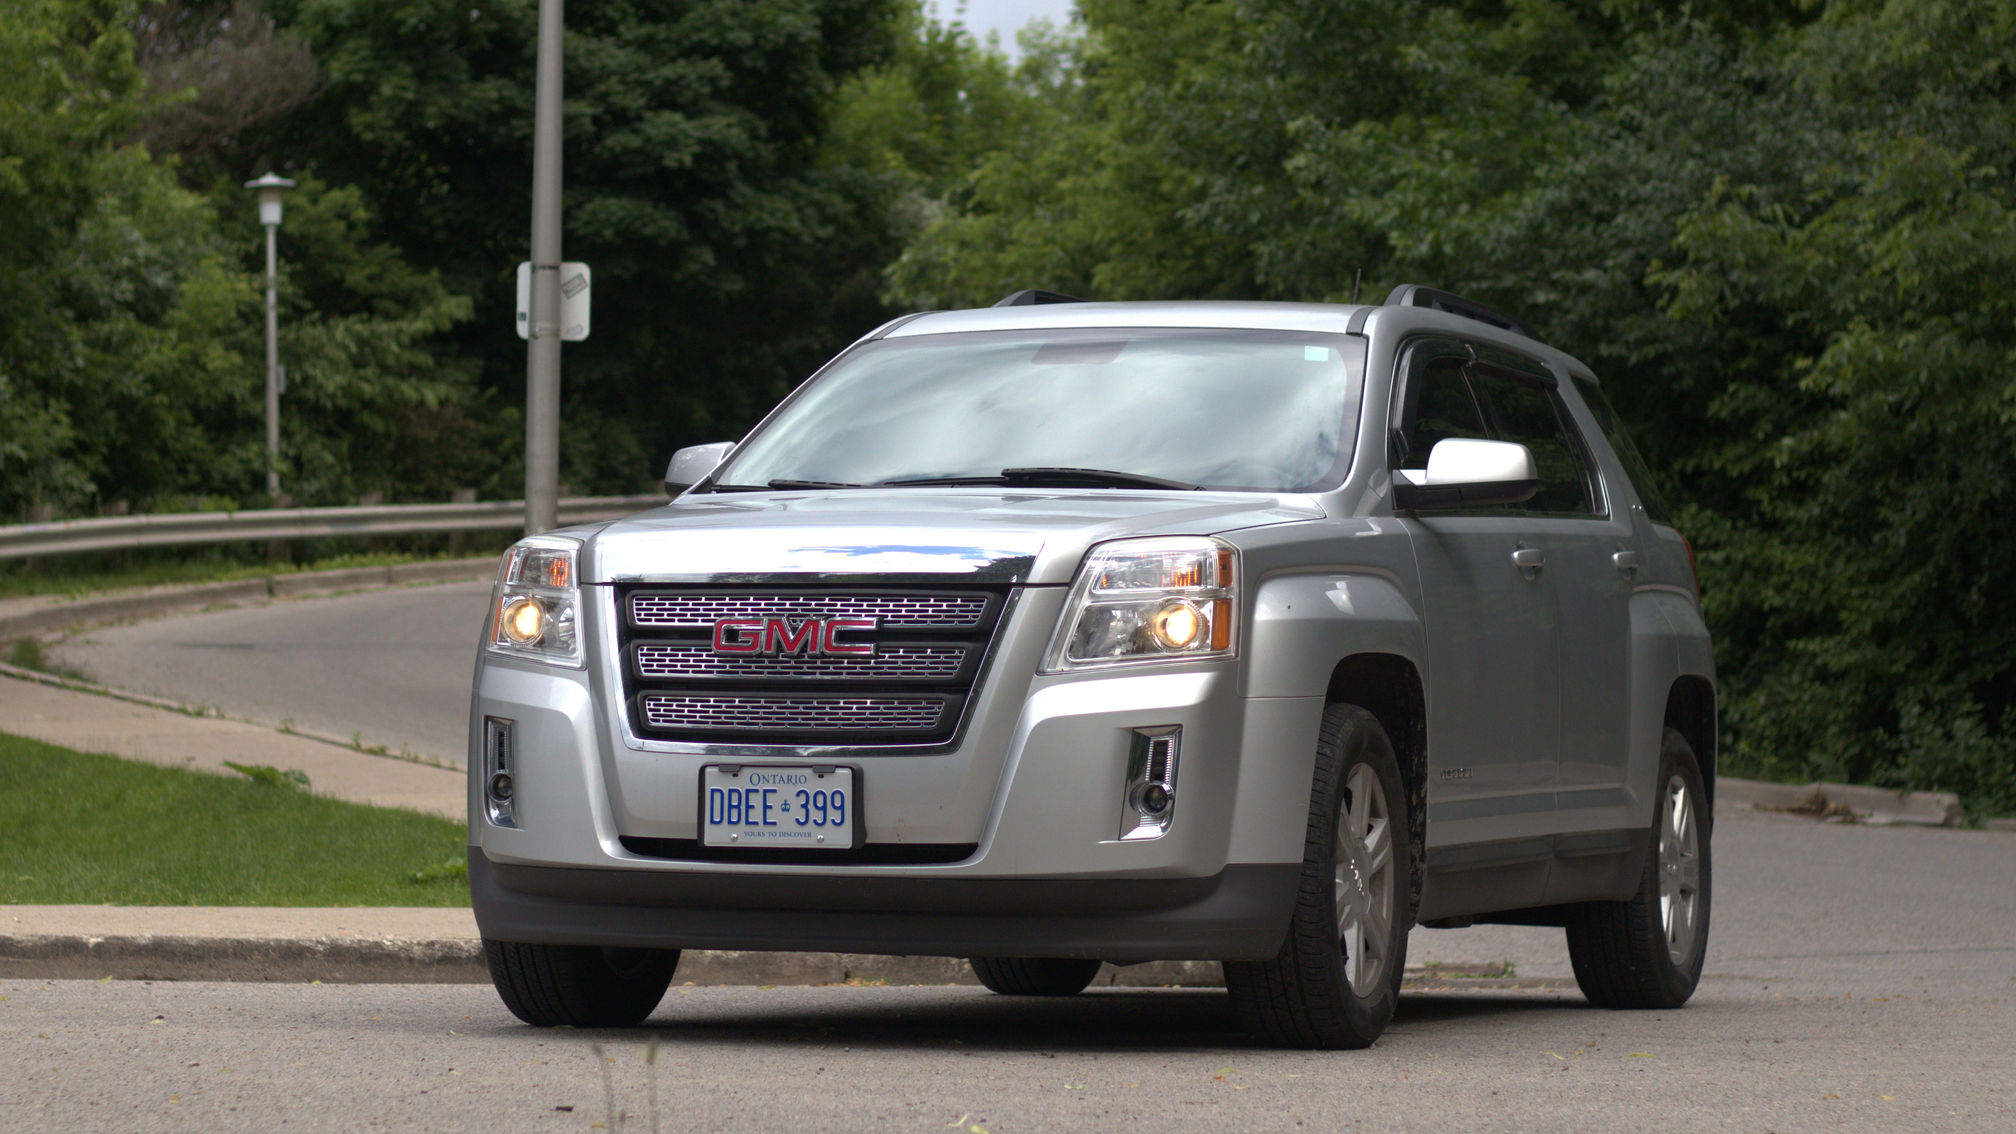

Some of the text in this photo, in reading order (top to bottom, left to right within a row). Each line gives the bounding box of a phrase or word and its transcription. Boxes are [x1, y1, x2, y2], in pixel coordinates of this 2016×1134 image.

[713, 616, 878, 656] GMC
[749, 773, 807, 786] ONTARIO
[709, 788, 846, 827] DBEE 399
[778, 831, 812, 839] DISCOVER
